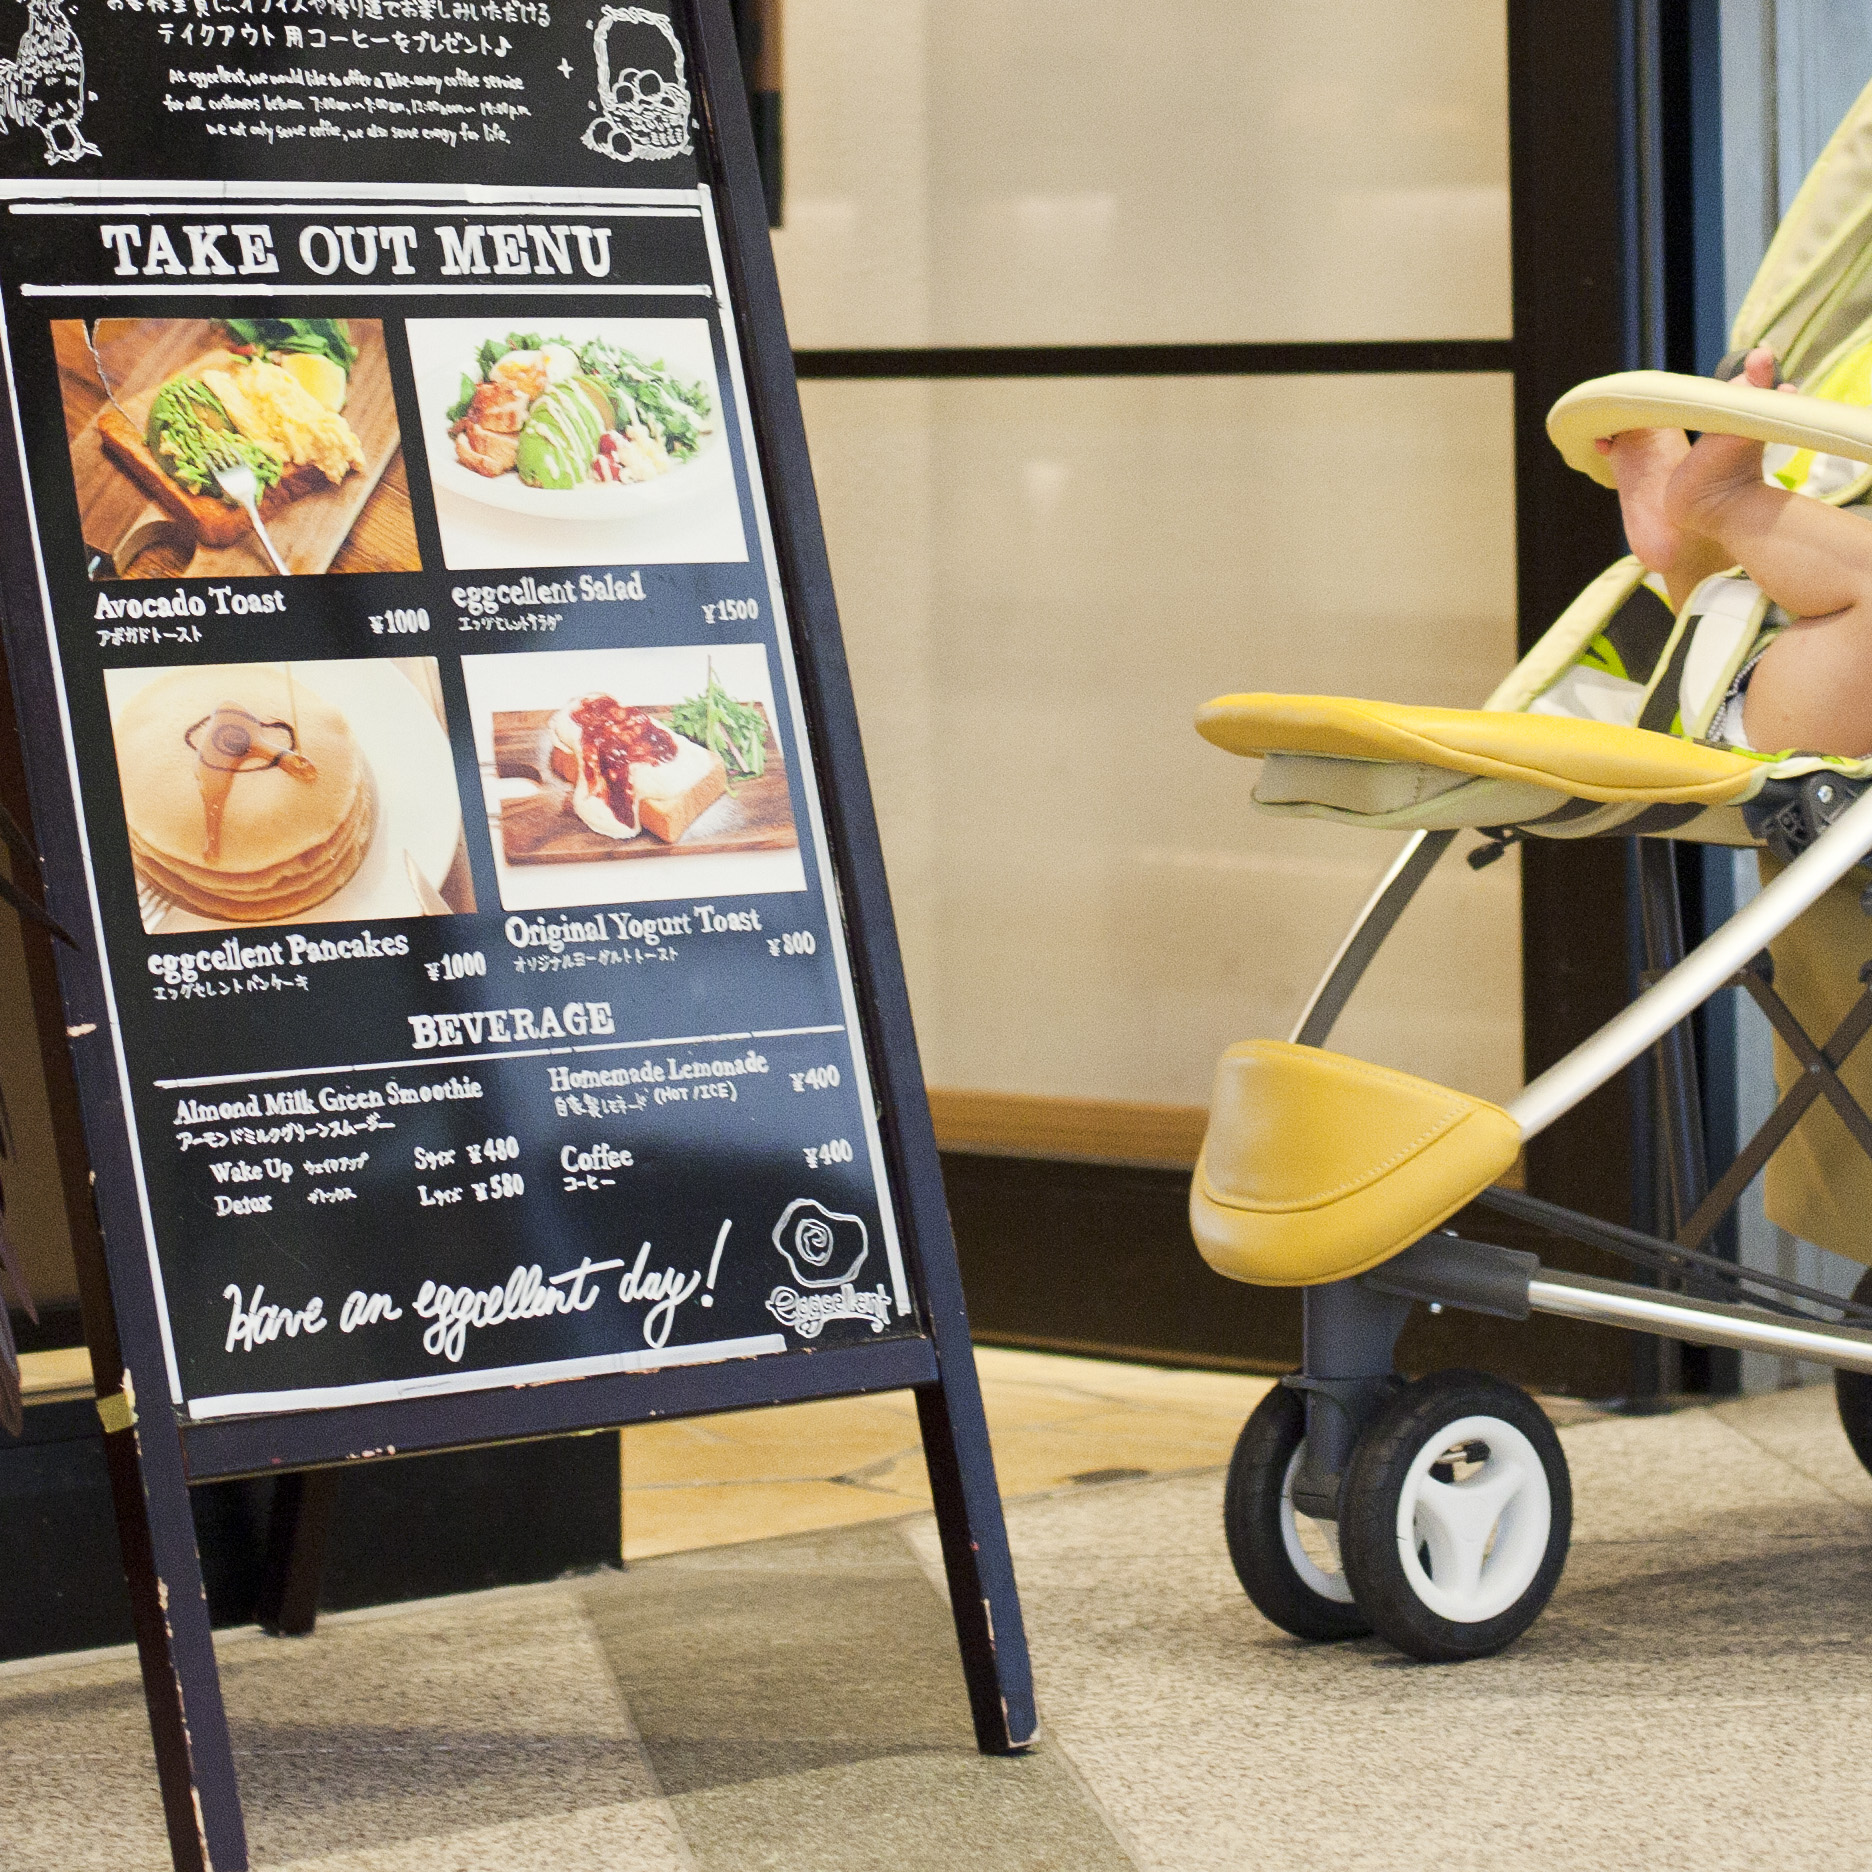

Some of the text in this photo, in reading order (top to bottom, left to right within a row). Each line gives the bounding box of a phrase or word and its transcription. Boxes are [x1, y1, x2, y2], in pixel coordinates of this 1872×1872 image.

[100, 223, 613, 278] TAKE OUT MENU
[94, 585, 431, 635] Avocado Toast ¥1000
[450, 569, 760, 625] eggcellent Salad ¥1500
[146, 929, 488, 984] eggcellent Pancakes ¥1000
[504, 905, 816, 958] Original Yogurt Toast ¥800
[408, 1001, 616, 1051] BEVERAGE
[547, 1049, 841, 1093] Homemade Lemonade ¥400
[172, 1075, 484, 1126] Almond Milk Green Smoothie
[209, 1158, 294, 1184] Wake Up
[465, 1135, 520, 1164] ¥480
[560, 1138, 854, 1173] Coffee ¥400
[213, 1193, 273, 1217] Detox
[470, 1172, 526, 1203] ¥580
[562, 1174, 617, 1192] コーヒー
[223, 1218, 734, 1363] Have an eggcellent day!
